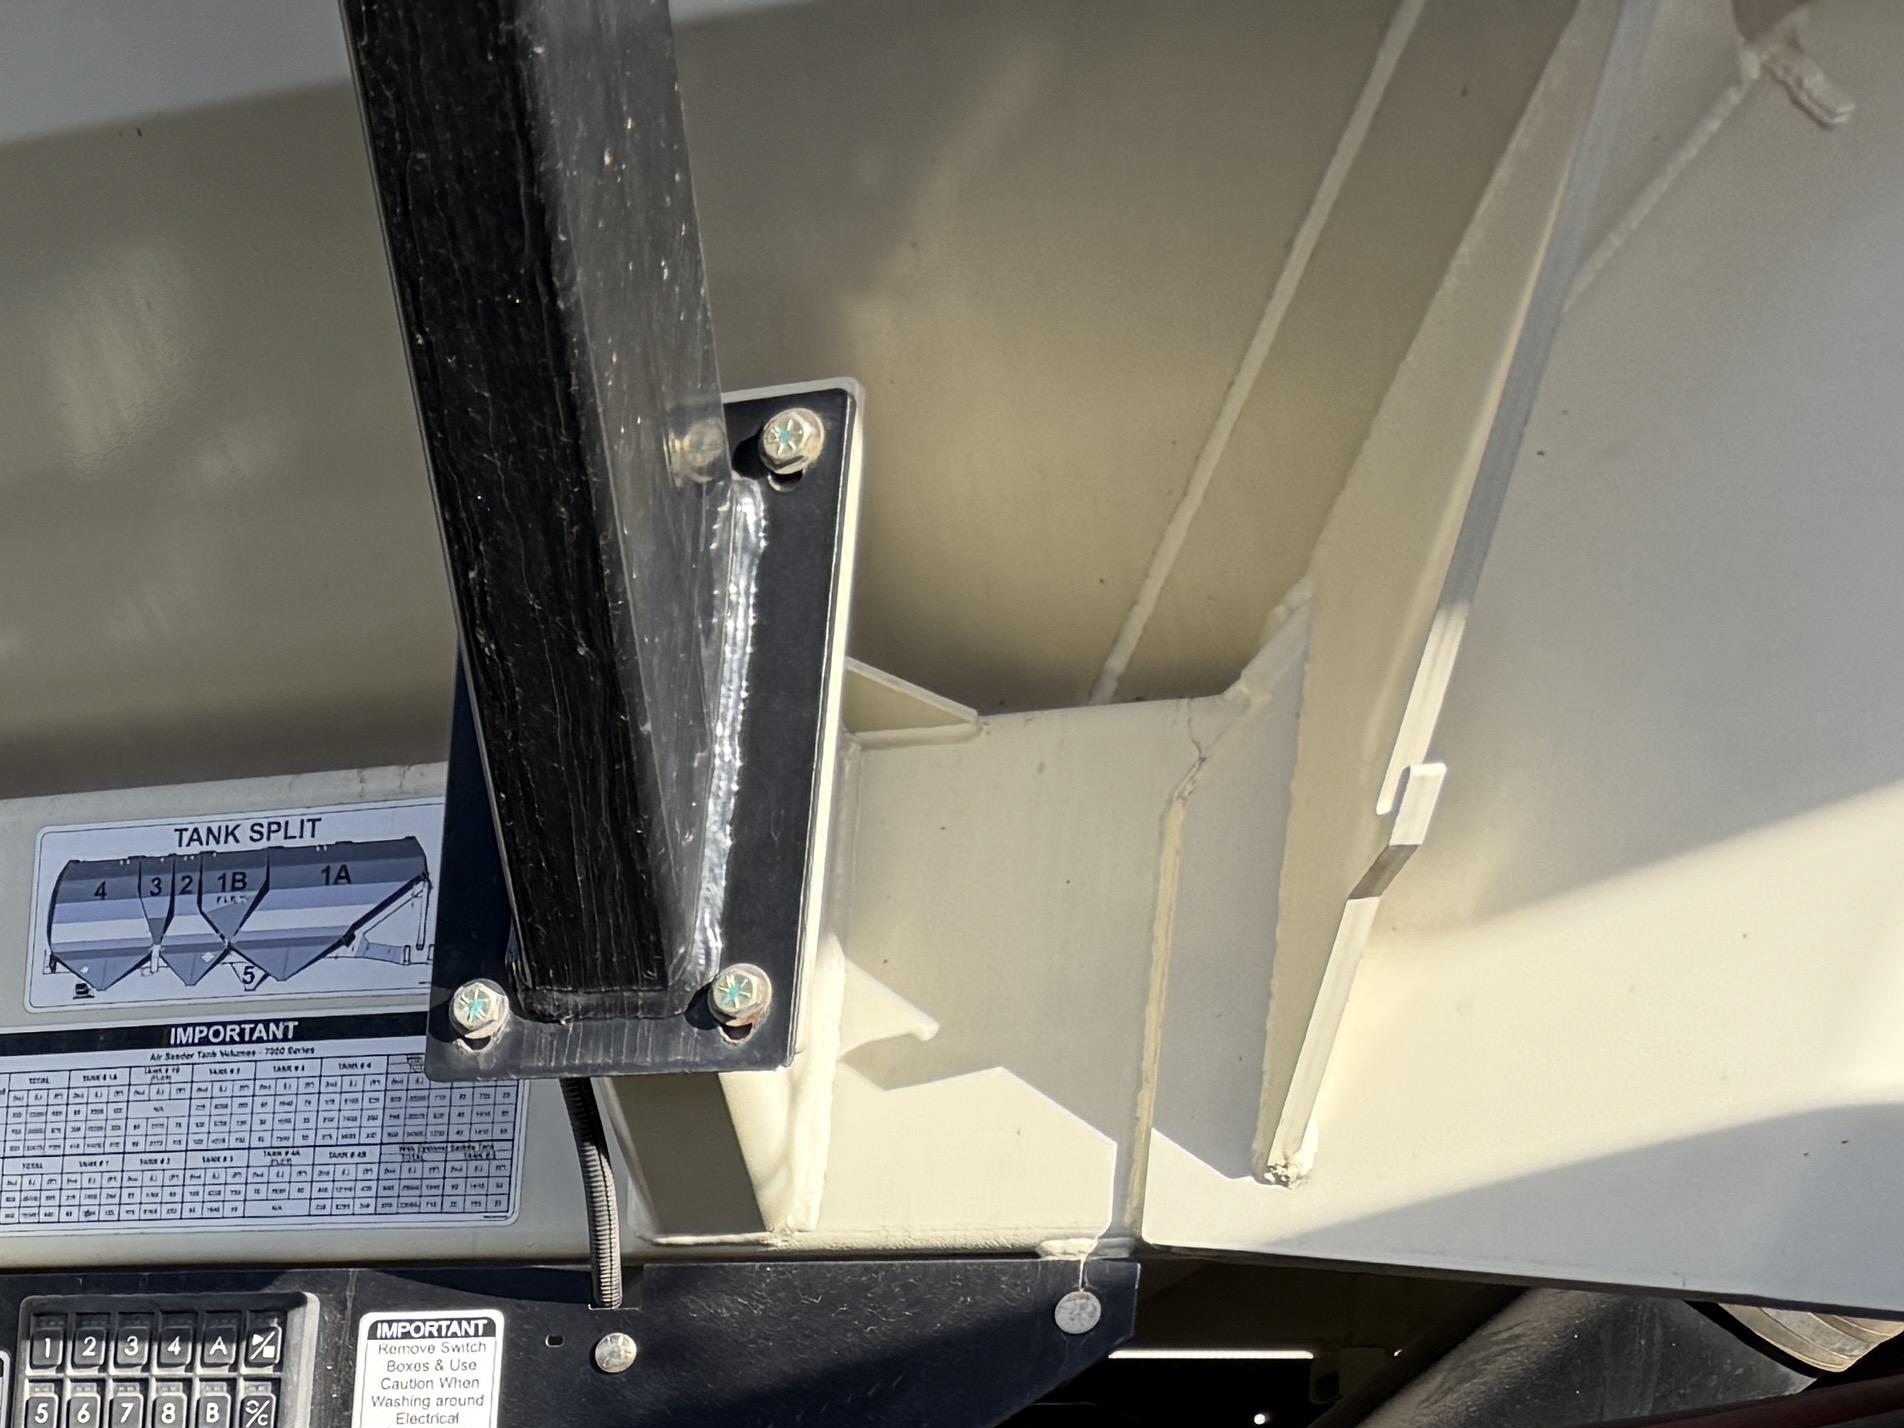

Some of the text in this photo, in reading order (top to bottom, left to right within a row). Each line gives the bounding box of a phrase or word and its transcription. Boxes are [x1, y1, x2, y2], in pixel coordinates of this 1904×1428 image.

[174, 818, 322, 847] TANK SPLIT
[94, 865, 352, 900] 4 3 2 1B 1A
[242, 966, 255, 984] 5
[170, 1021, 299, 1045] IMPORTANT
[377, 1320, 487, 1338] IMPORTANT
[44, 1336, 227, 1358] 1 2 3 4 A
[379, 1342, 486, 1355] Remove Switch
[387, 1359, 477, 1372] Boxes & Use
[381, 1377, 479, 1390] Caution When
[372, 1395, 484, 1409] Washing around
[35, 1403, 48, 1423] 5
[77, 1403, 89, 1422] 6
[121, 1403, 133, 1422] 7
[162, 1403, 175, 1423] 8
[207, 1403, 218, 1422] B
[397, 1413, 459, 1424] Electrical
